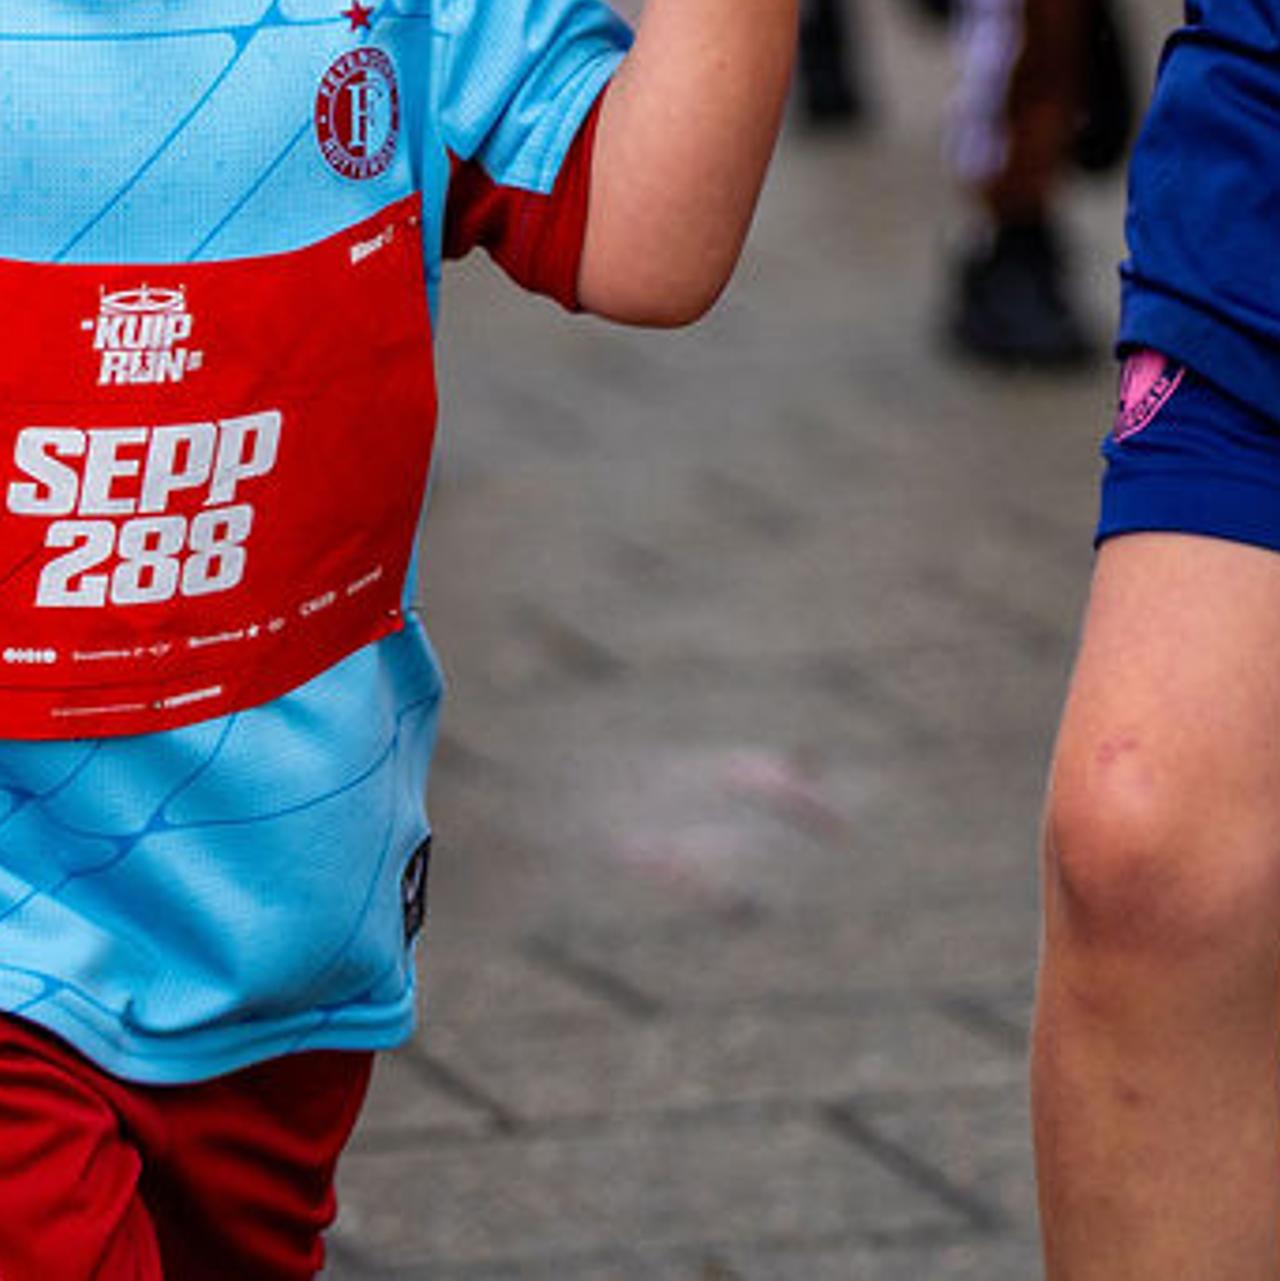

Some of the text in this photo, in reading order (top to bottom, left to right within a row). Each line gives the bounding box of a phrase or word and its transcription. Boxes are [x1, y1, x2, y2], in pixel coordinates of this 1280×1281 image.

[93, 313, 193, 351] KUIP
[97, 347, 188, 386] RUN
[6, 409, 282, 517] SEPP
[35, 504, 255, 608] 288
